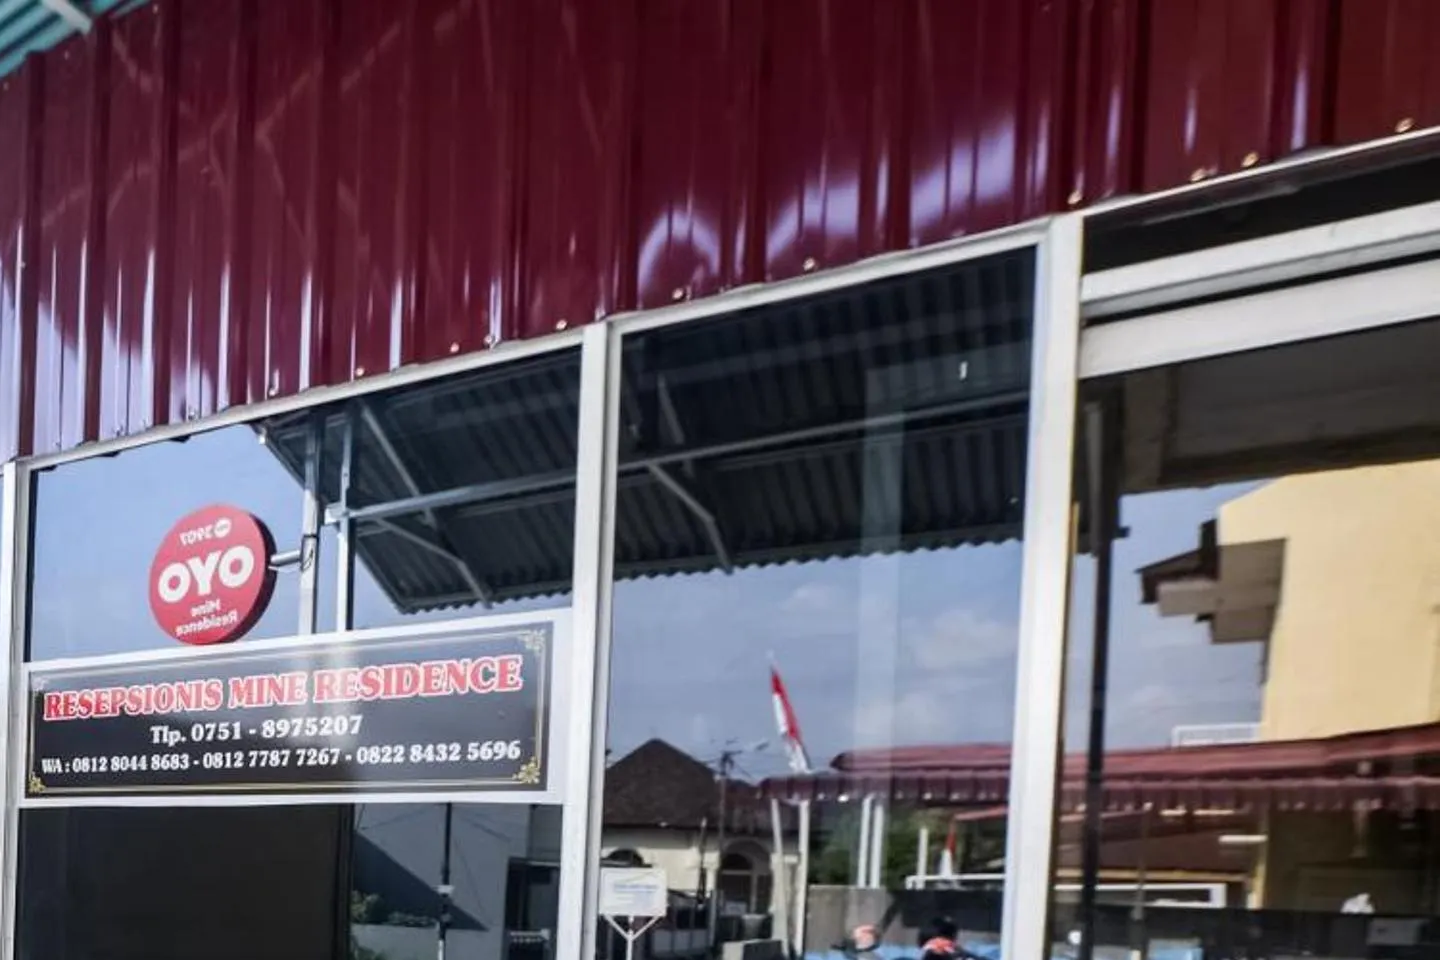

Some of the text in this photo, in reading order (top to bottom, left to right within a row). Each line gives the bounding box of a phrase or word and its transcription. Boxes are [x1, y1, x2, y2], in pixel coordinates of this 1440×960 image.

[44, 654, 523, 721] RESEPSIONIS MINE RESIDENCE
[190, 721, 243, 742] 0751
[262, 715, 363, 739] 8975207
[72, 757, 108, 773] 0812
[110, 755, 148, 772] 8044
[151, 753, 190, 770] 8683
[202, 751, 245, 769] 0812
[248, 749, 291, 768] 7787
[296, 747, 341, 767] 7267
[356, 745, 405, 764] 0822
[410, 742, 462, 763] 8432
[466, 740, 522, 761] 5696
